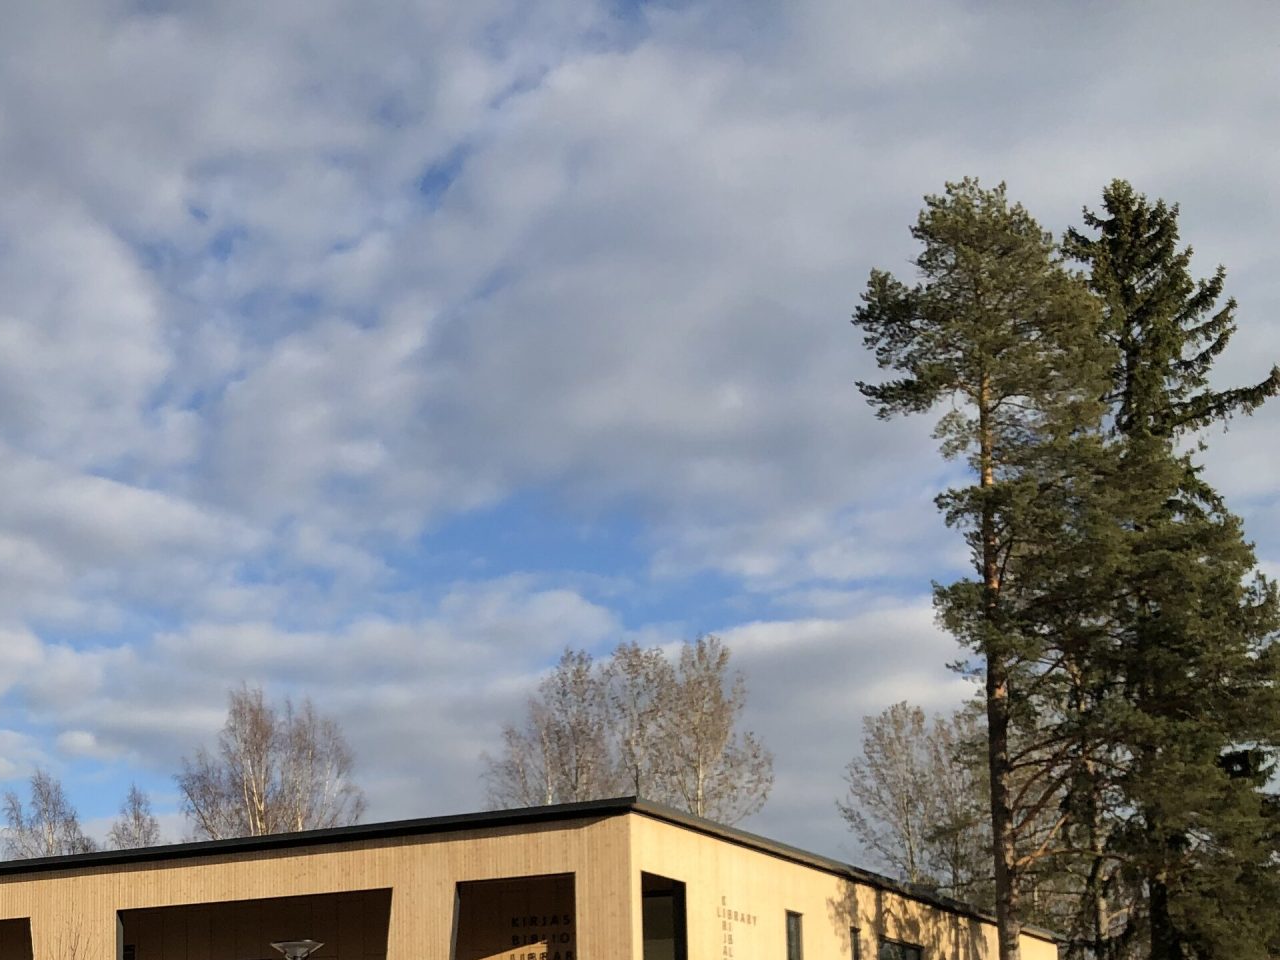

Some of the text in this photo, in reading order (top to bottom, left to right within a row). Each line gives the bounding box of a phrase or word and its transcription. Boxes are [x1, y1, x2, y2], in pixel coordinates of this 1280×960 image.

[511, 914, 571, 928] KIRJAS
[717, 906, 757, 926] LIBRARY
[511, 932, 572, 946] BIBLIO
